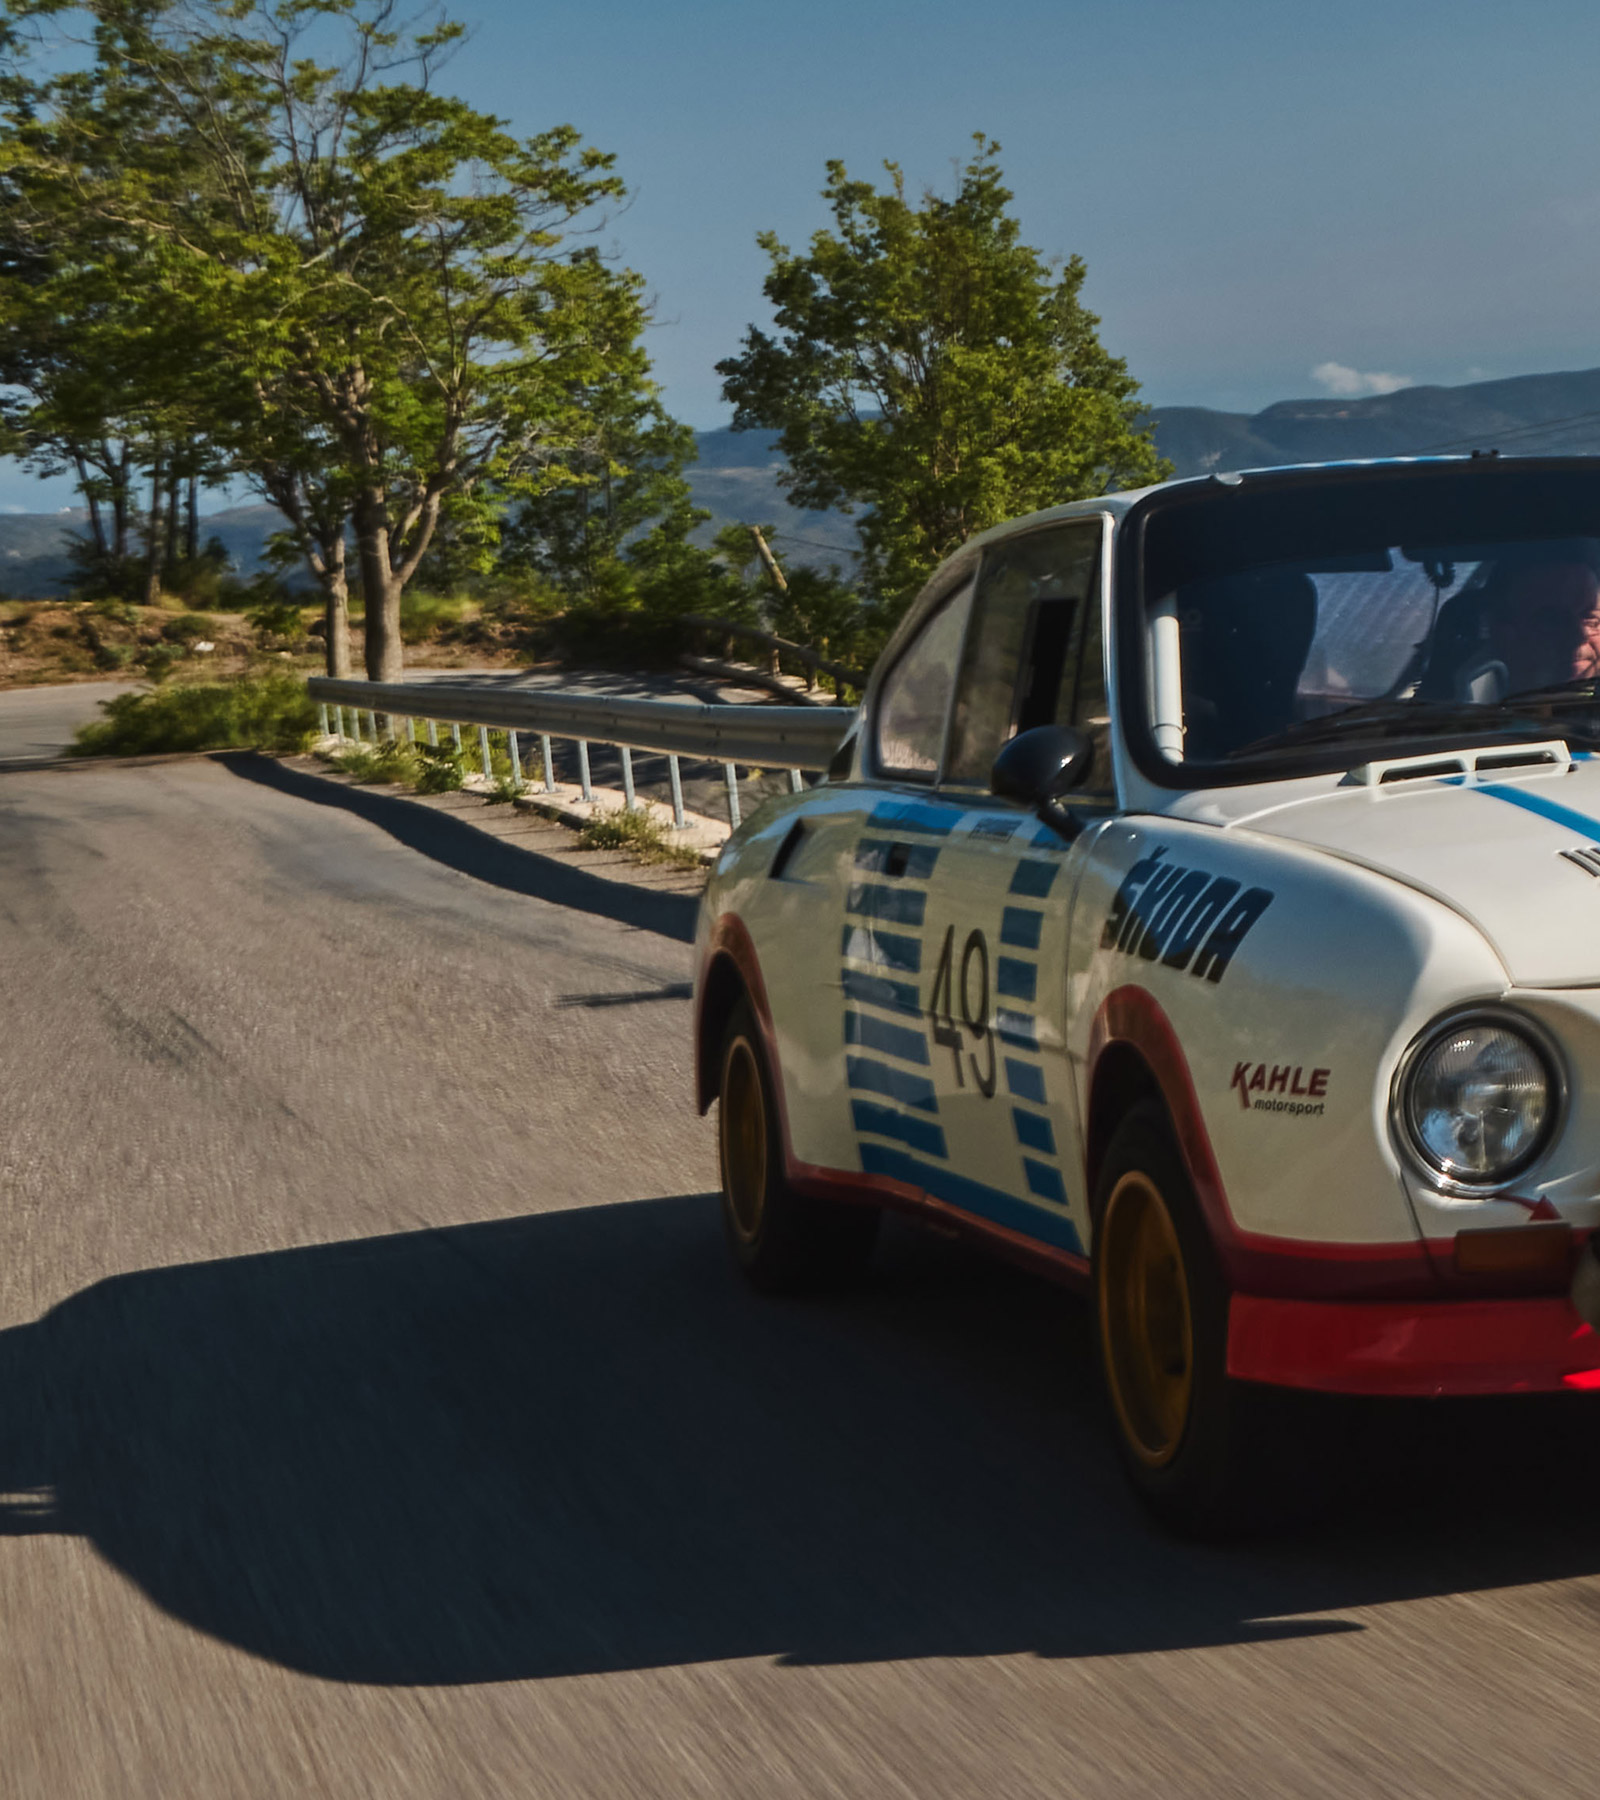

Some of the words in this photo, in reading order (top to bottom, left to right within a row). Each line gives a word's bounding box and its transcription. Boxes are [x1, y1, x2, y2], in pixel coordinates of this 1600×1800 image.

[1099, 845, 1274, 984] ŠKODA
[930, 923, 997, 1099] 49
[1231, 1062, 1332, 1110] KAHLE
[1254, 1098, 1325, 1116] motorsport
